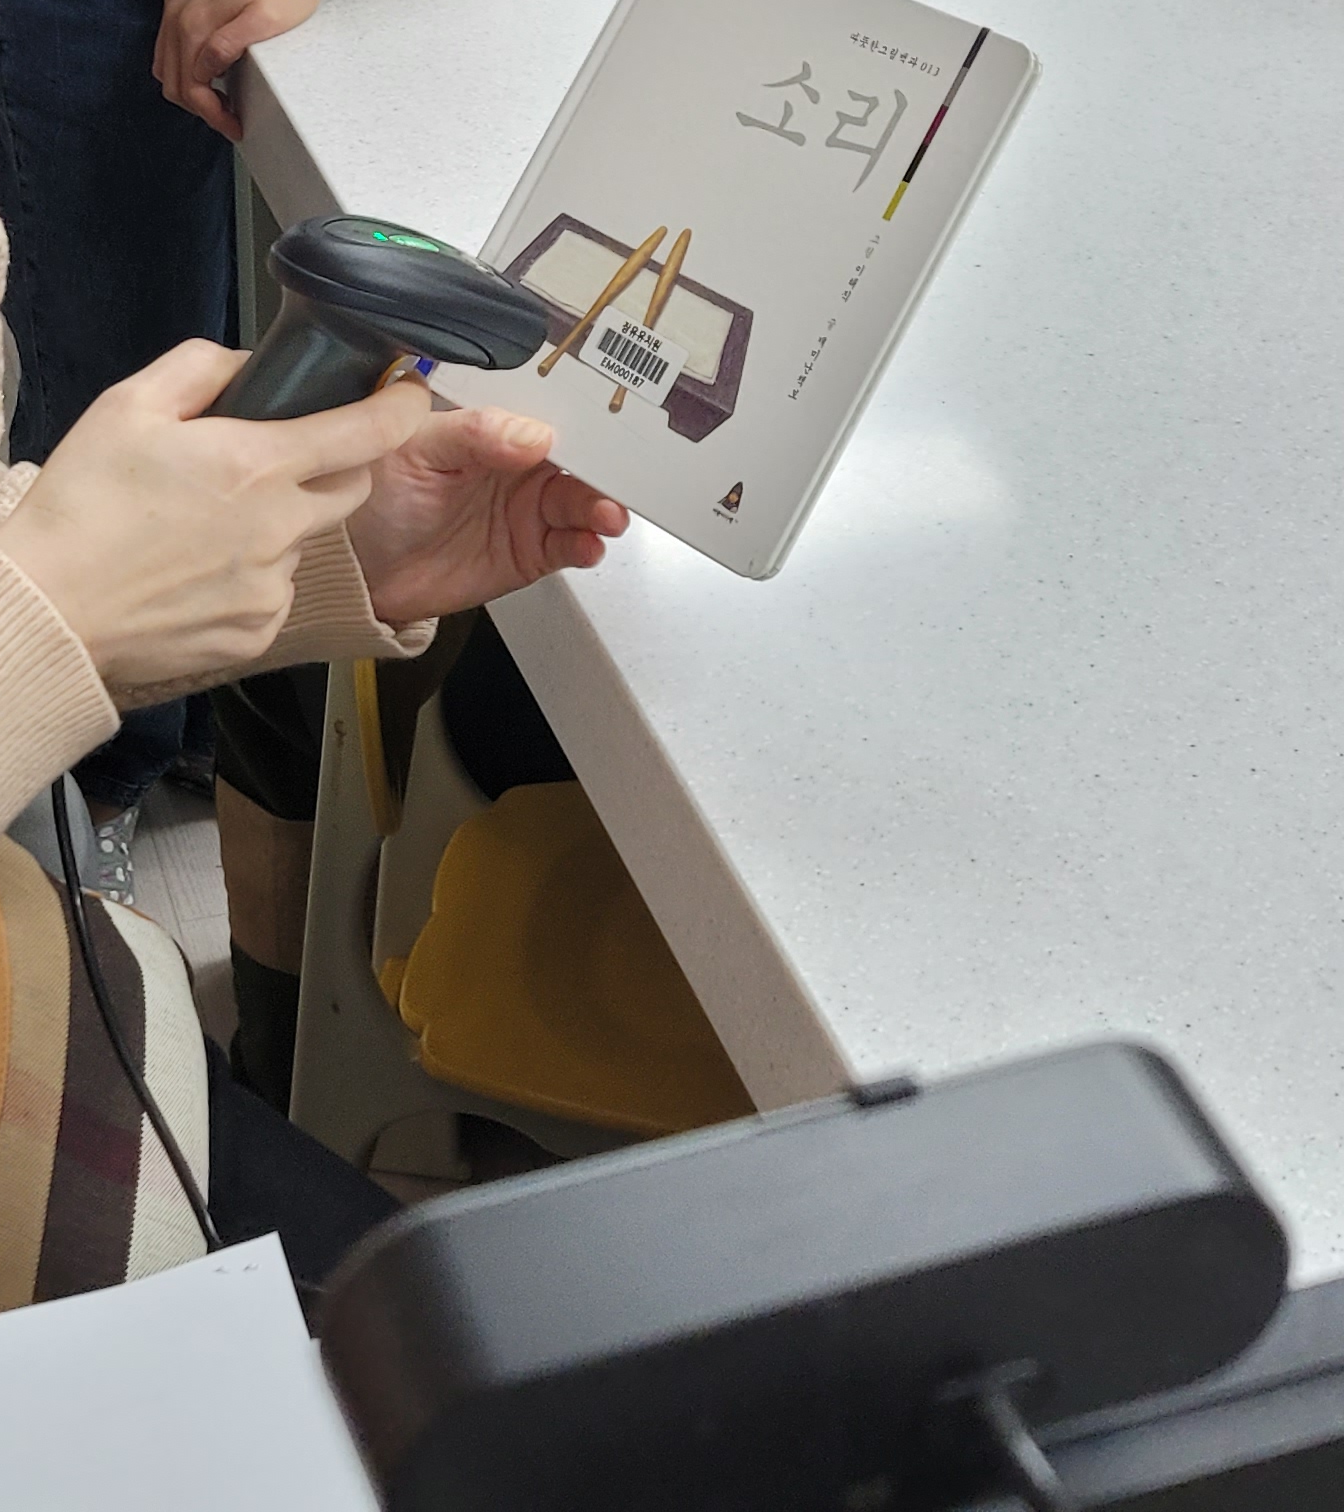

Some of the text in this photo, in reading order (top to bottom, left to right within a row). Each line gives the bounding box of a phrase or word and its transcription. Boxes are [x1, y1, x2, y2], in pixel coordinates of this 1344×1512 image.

[920, 60, 941, 77] 013
[735, 60, 908, 193] 소리
[599, 358, 646, 389] EM000187
